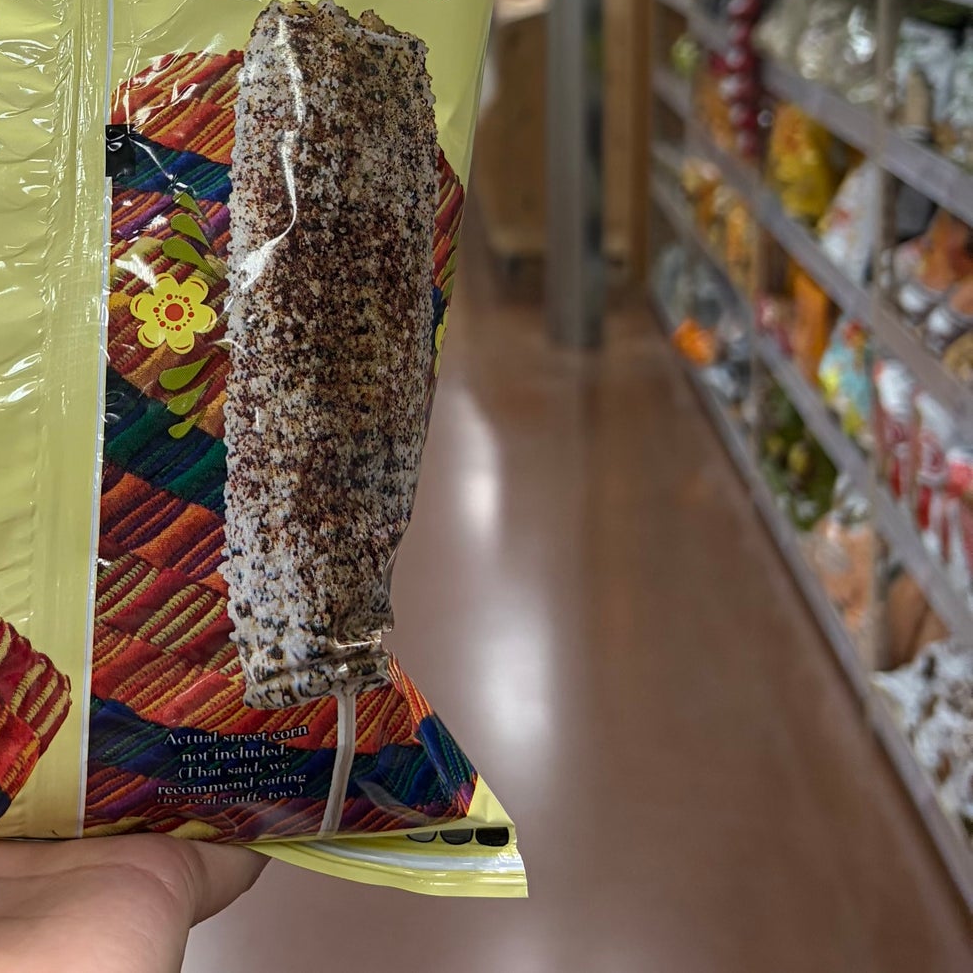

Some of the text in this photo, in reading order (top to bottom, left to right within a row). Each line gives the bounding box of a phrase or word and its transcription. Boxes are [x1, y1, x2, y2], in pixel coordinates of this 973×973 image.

[164, 725, 308, 745] Actual street corn
[182, 745, 289, 762] not included.
[178, 767, 221, 779] (That
[158, 773, 307, 795] recommend eating
